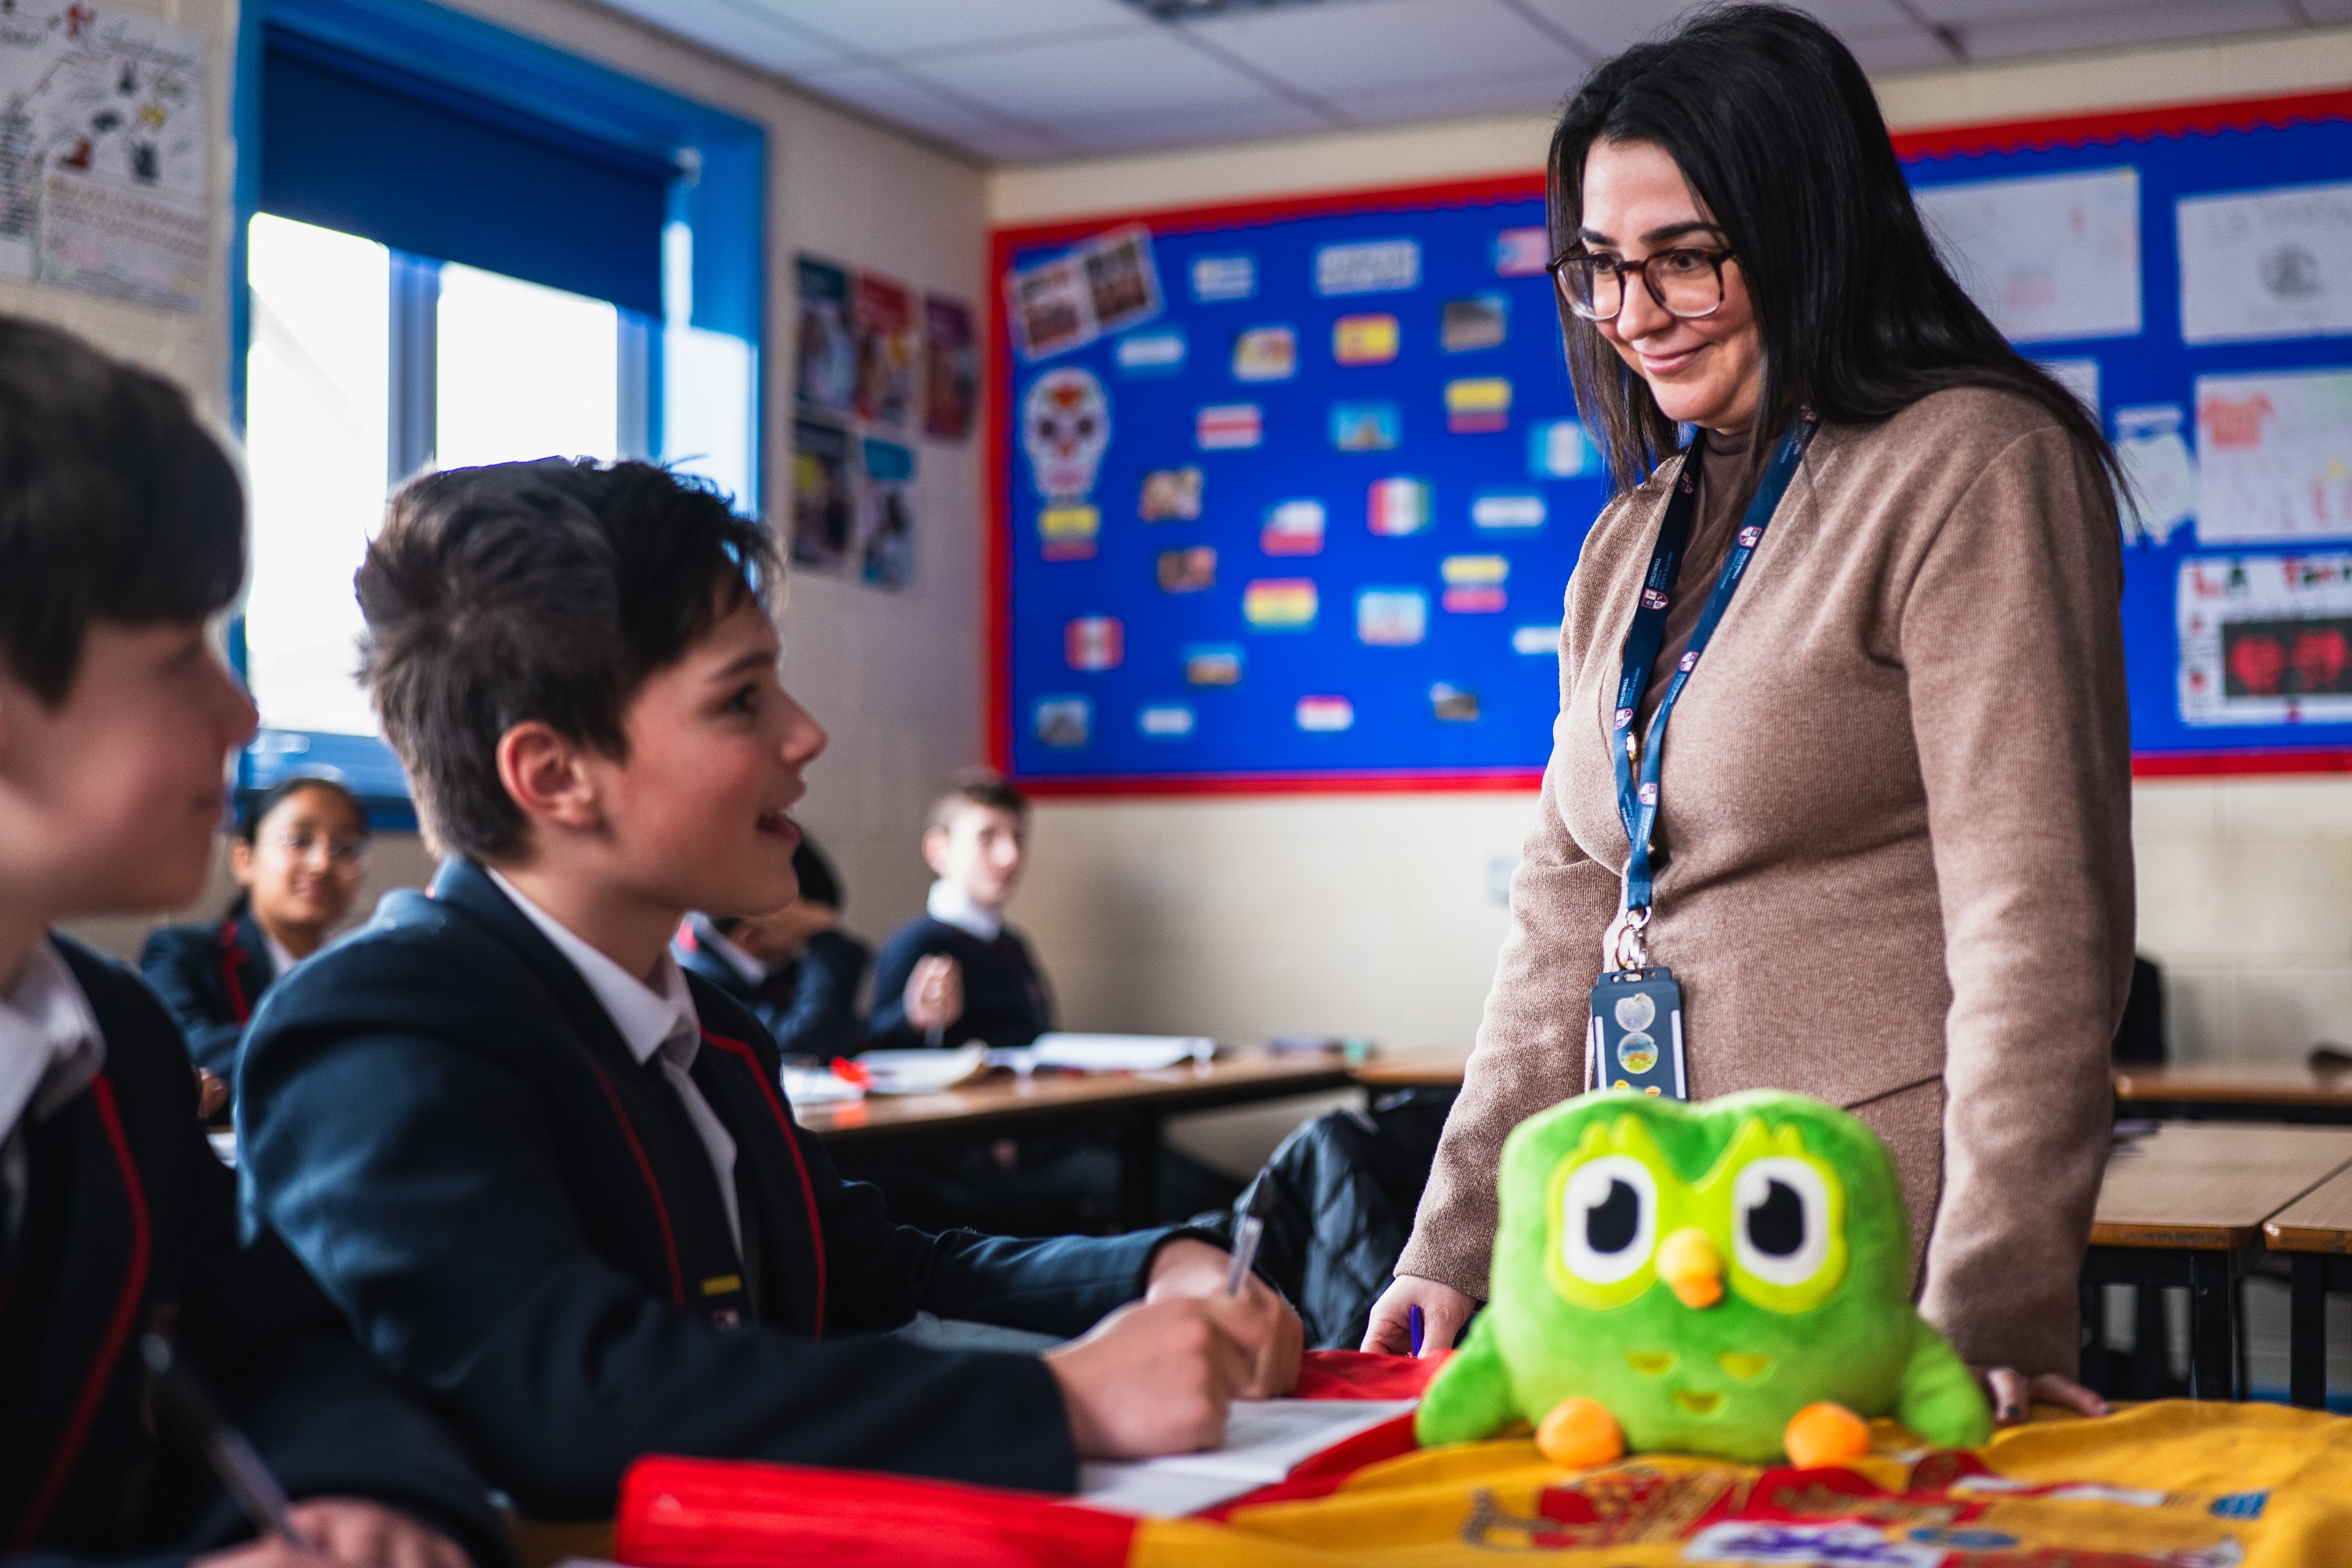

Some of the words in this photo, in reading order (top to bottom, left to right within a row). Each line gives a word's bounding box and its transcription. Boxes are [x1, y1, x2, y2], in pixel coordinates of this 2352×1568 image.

[1648, 557, 1661, 586] CHILDWALL
[1664, 551, 1673, 572] ACADEMY
[1732, 548, 1750, 580] CHILDWALL
[1618, 676, 1628, 708] CHILDWALL
[1632, 666, 1641, 688] ACADEMY
[1622, 807, 1633, 839] CHILDWALL
